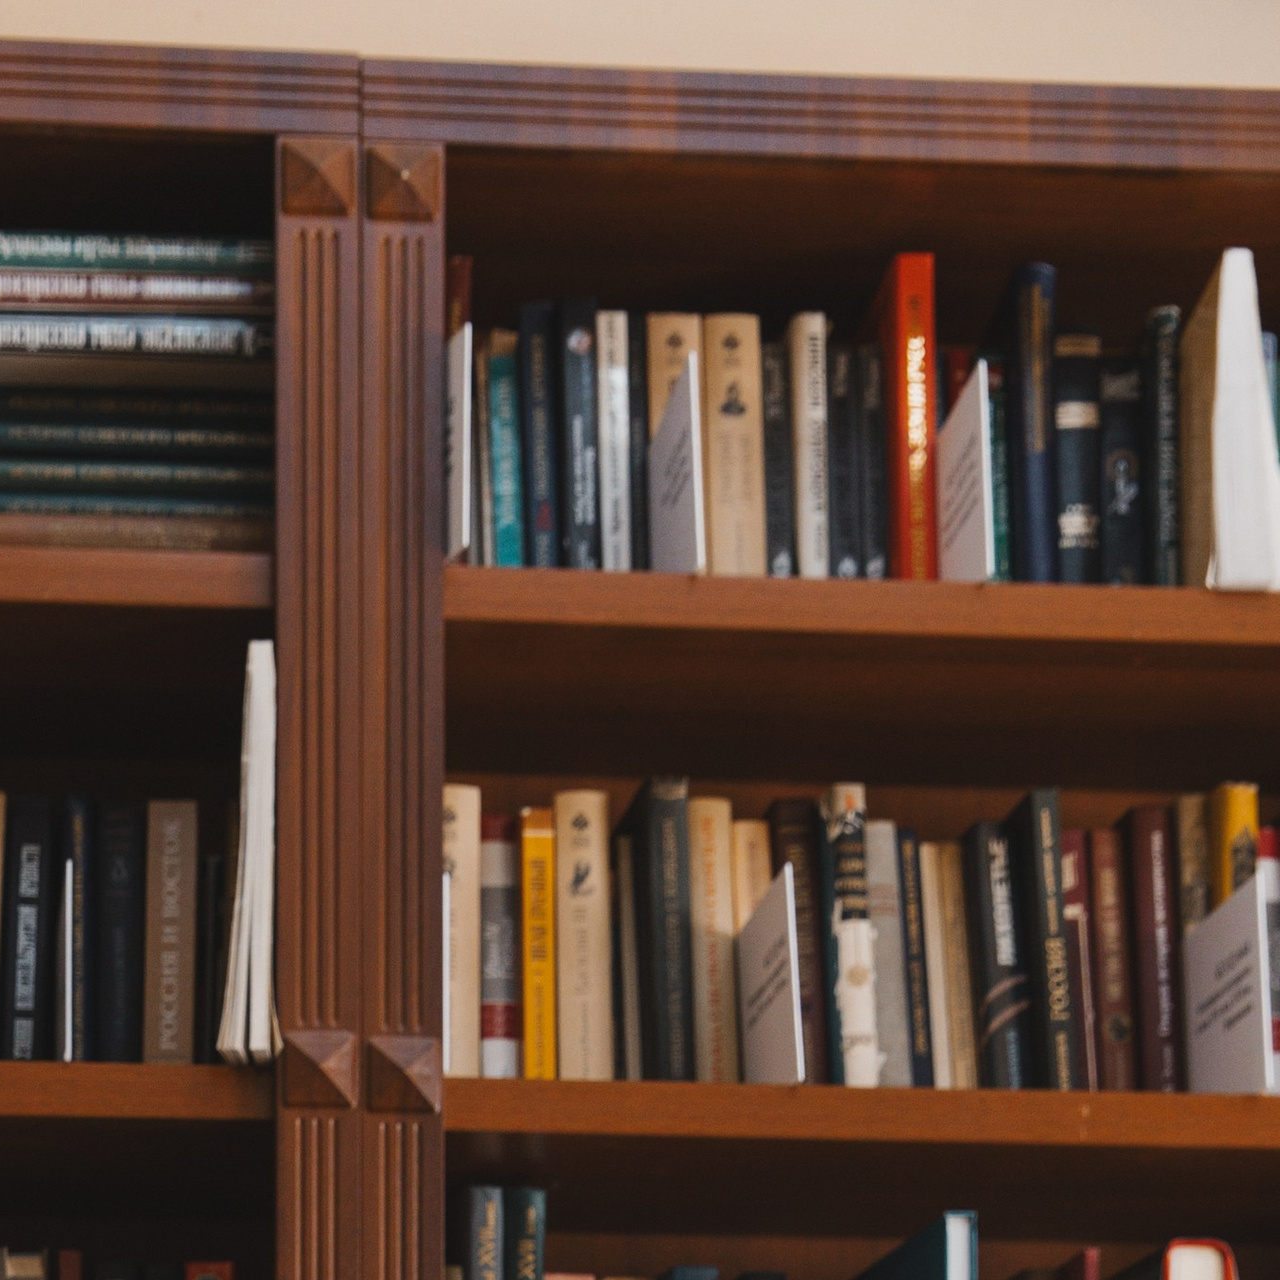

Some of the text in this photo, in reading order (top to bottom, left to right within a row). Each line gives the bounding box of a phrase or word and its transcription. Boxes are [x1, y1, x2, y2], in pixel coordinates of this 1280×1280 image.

[157, 817, 183, 1051] РОССИЯ И ВОСТОК
